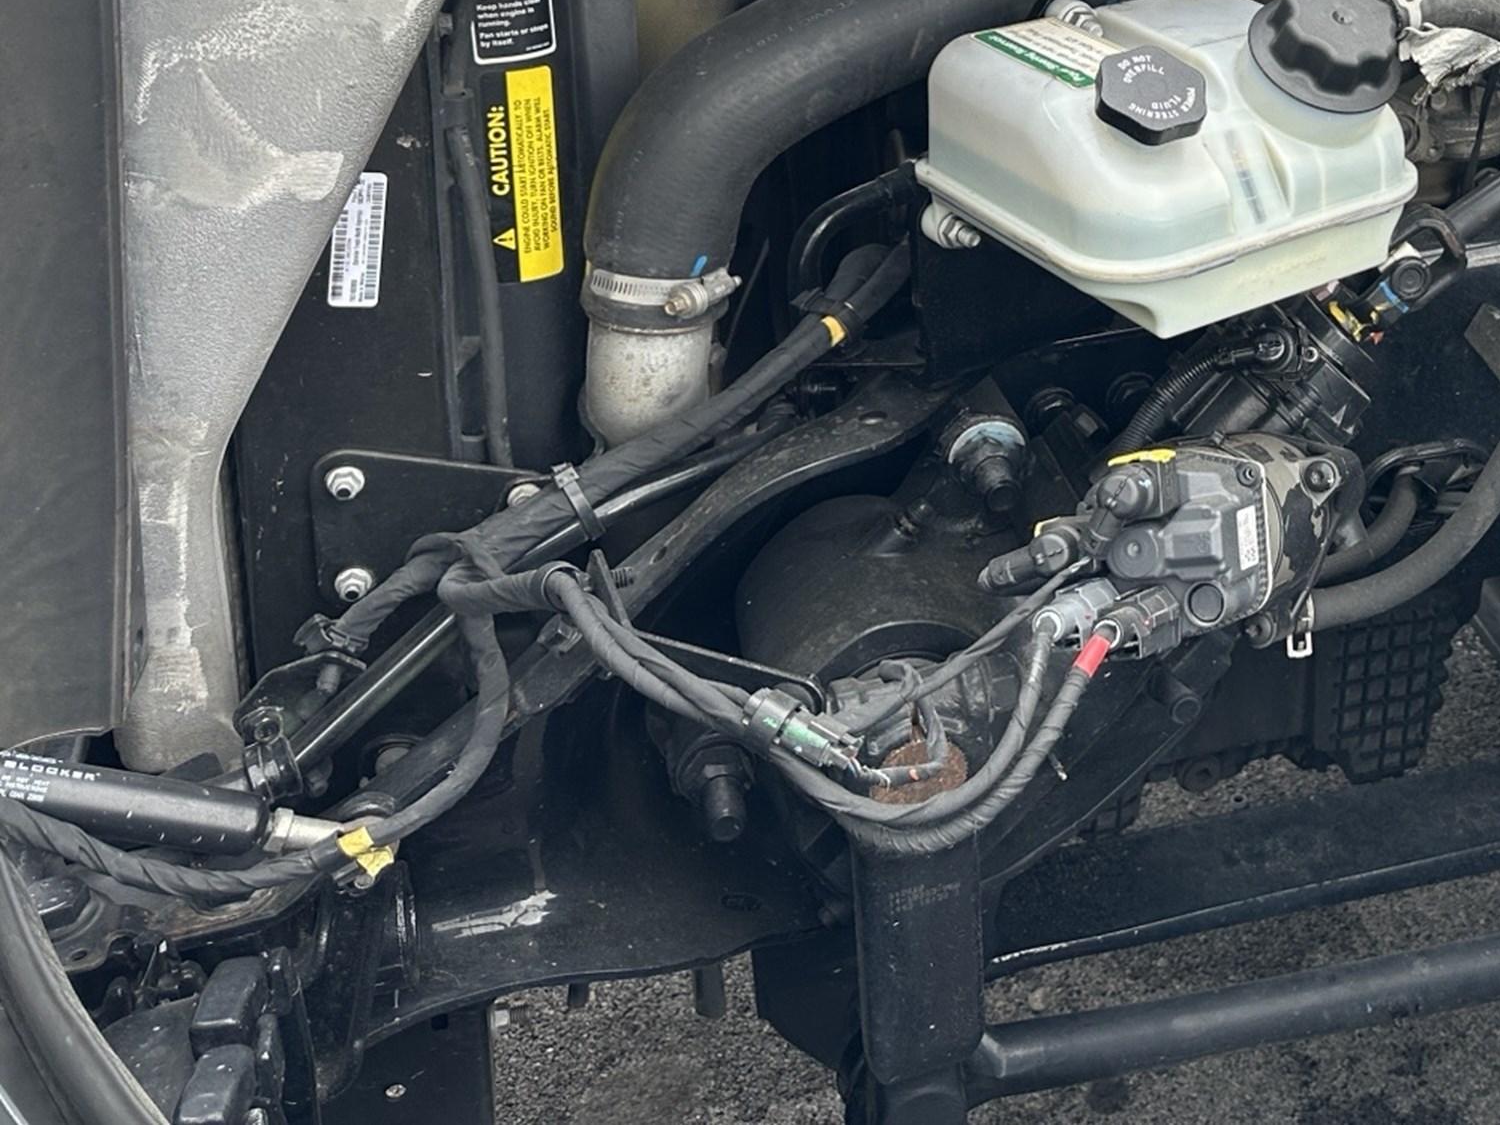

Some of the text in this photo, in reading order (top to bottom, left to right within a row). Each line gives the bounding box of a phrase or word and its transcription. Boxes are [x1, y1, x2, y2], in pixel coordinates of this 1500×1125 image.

[476, 2, 497, 13] Keep
[498, 0, 523, 10] hands
[477, 11, 499, 19] when
[500, 8, 526, 19] engine
[478, 19, 511, 29] running.
[479, 22, 549, 40] Fan starts or stops
[480, 39, 490, 49] by
[1117, 54, 1152, 70] DO NOT
[1123, 63, 1164, 84] OVERFILL
[524, 99, 533, 122] WHEN
[533, 97, 541, 114] WILL
[1128, 102, 1180, 120] STEERING
[1151, 94, 1181, 110] FLUID
[526, 125, 534, 139] OFF
[534, 117, 543, 142] ALARM
[487, 105, 510, 196] CAUTION:
[527, 141, 537, 175] IGNITION
[544, 133, 555, 175] AUTOMATIC
[538, 168, 546, 179] OR
[519, 176, 528, 196] START
[530, 177, 538, 197] TURN
[539, 181, 547, 196] FAN
[547, 178, 556, 203] BEFORE
[520, 199, 530, 223] COULD
[540, 197, 548, 210] ON
[549, 206, 558, 232] SOUND
[522, 226, 532, 253] ENGINE
[533, 229, 542, 251] AVOID
[541, 213, 551, 249] WORKING
